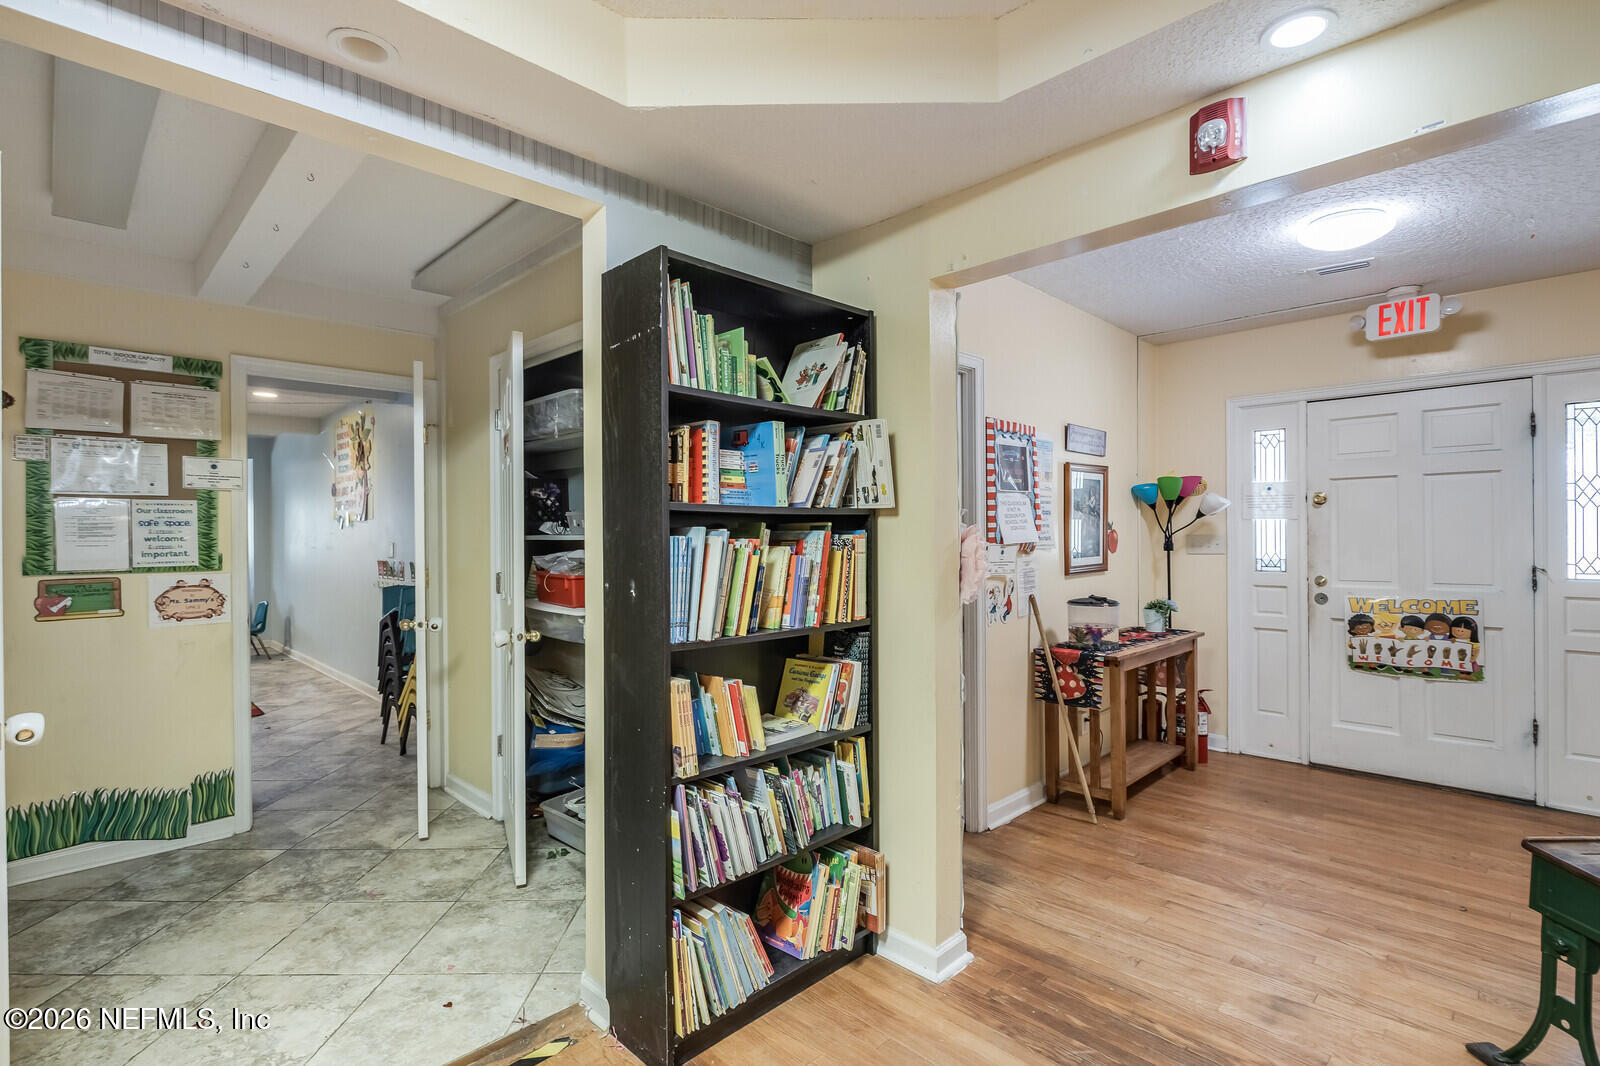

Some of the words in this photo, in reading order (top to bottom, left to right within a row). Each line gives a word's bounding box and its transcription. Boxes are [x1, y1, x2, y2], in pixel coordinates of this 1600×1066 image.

[1378, 296, 1430, 336] EXIT
[138, 354, 166, 362] CAPACITY
[138, 519, 160, 527] safe
[1348, 597, 1479, 615] WELCOME
